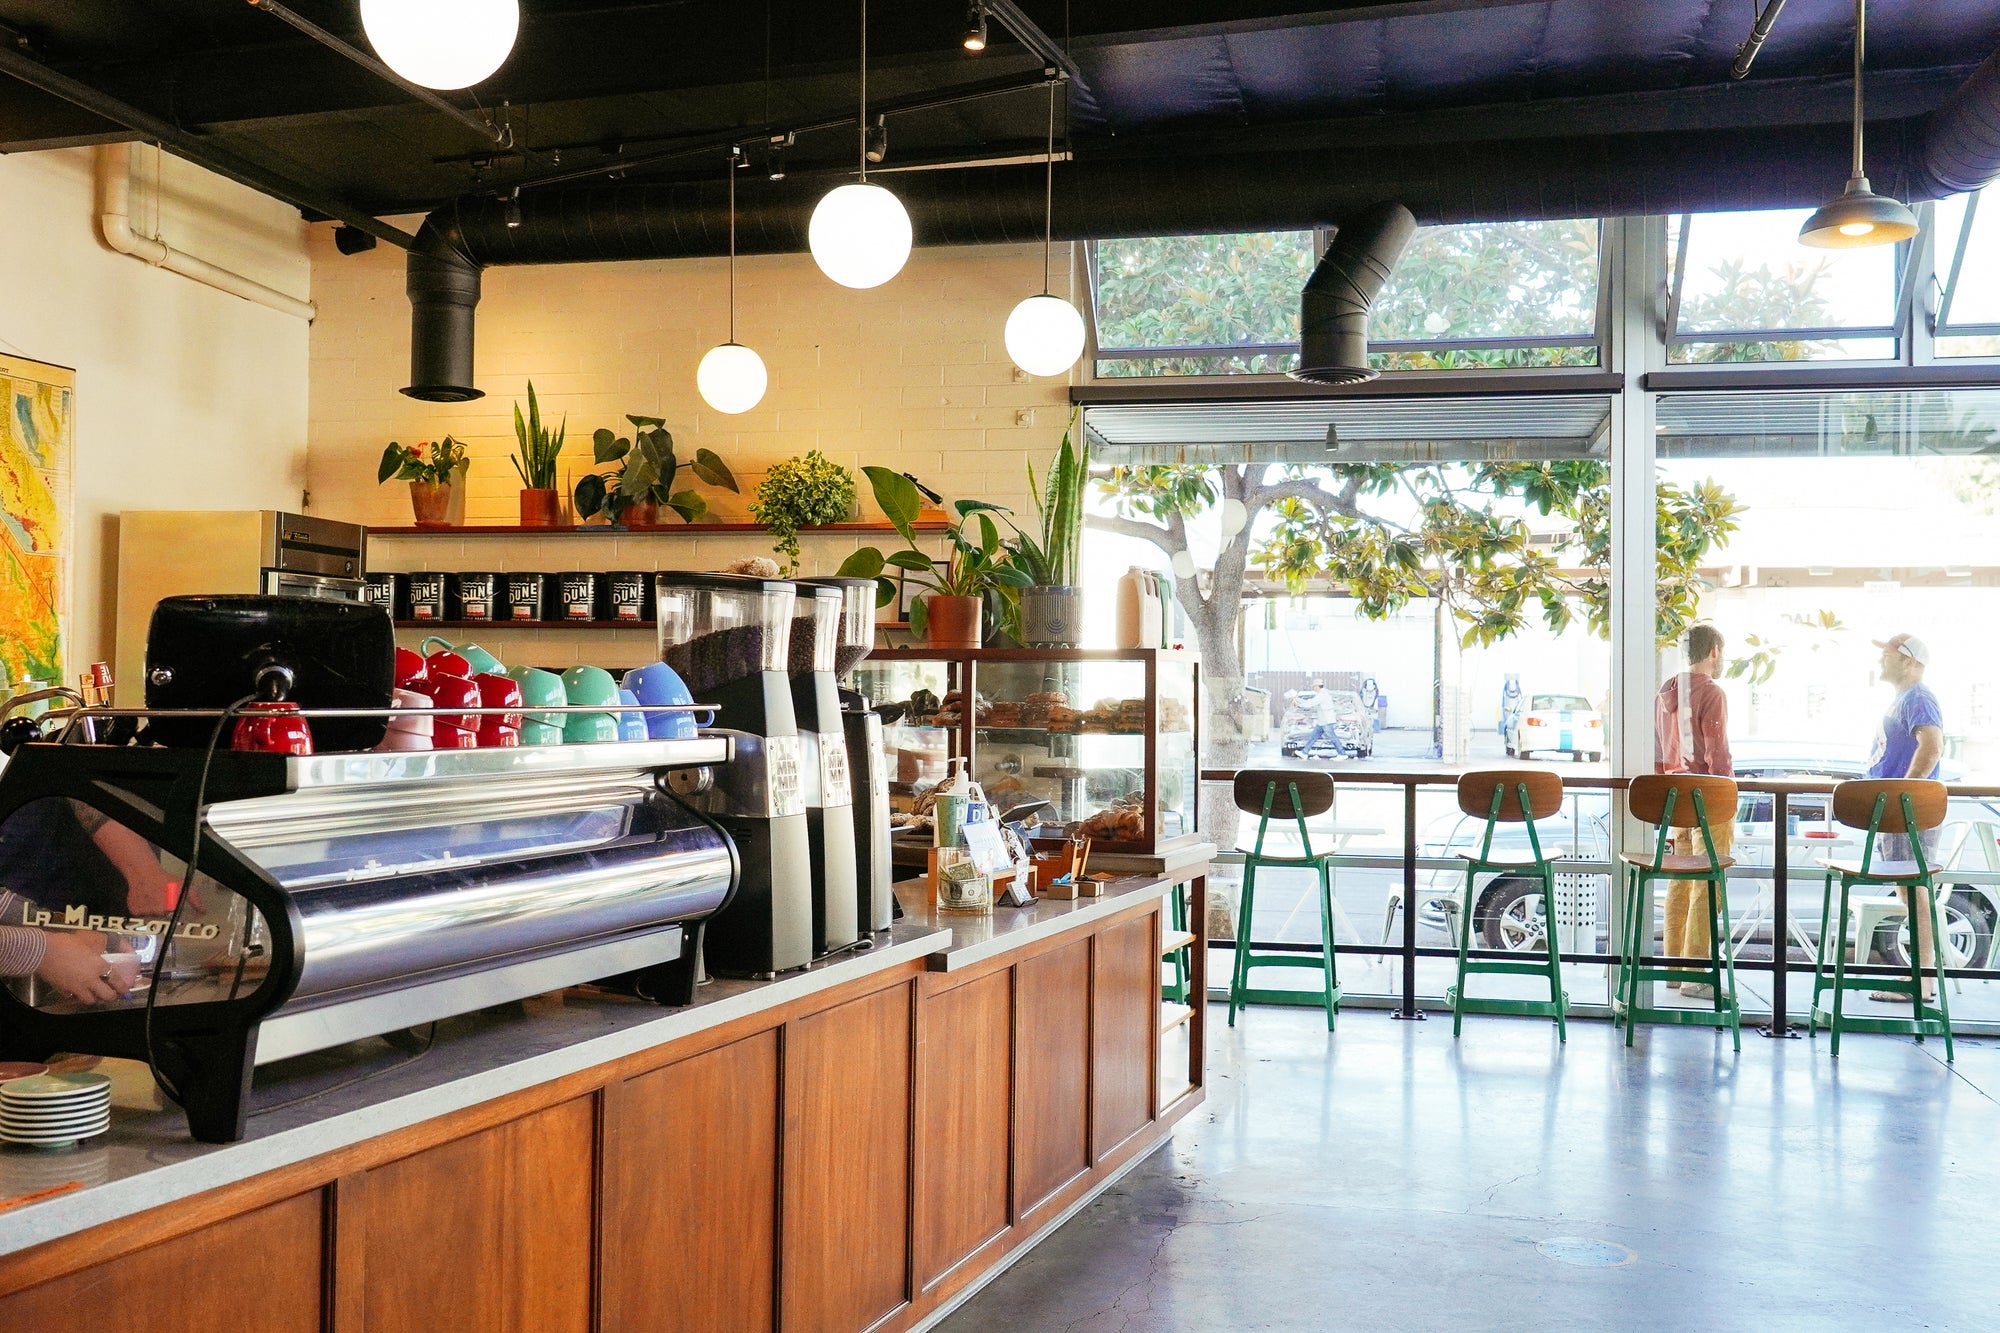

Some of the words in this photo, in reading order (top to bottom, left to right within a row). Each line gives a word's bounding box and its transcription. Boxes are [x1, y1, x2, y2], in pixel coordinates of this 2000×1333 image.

[367, 584, 389, 602] UNE
[411, 582, 438, 604] DUNE
[462, 582, 493, 603] DUNE
[509, 583, 538, 604] DUNE
[563, 582, 595, 604] DUNE
[613, 583, 645, 604] DUNE
